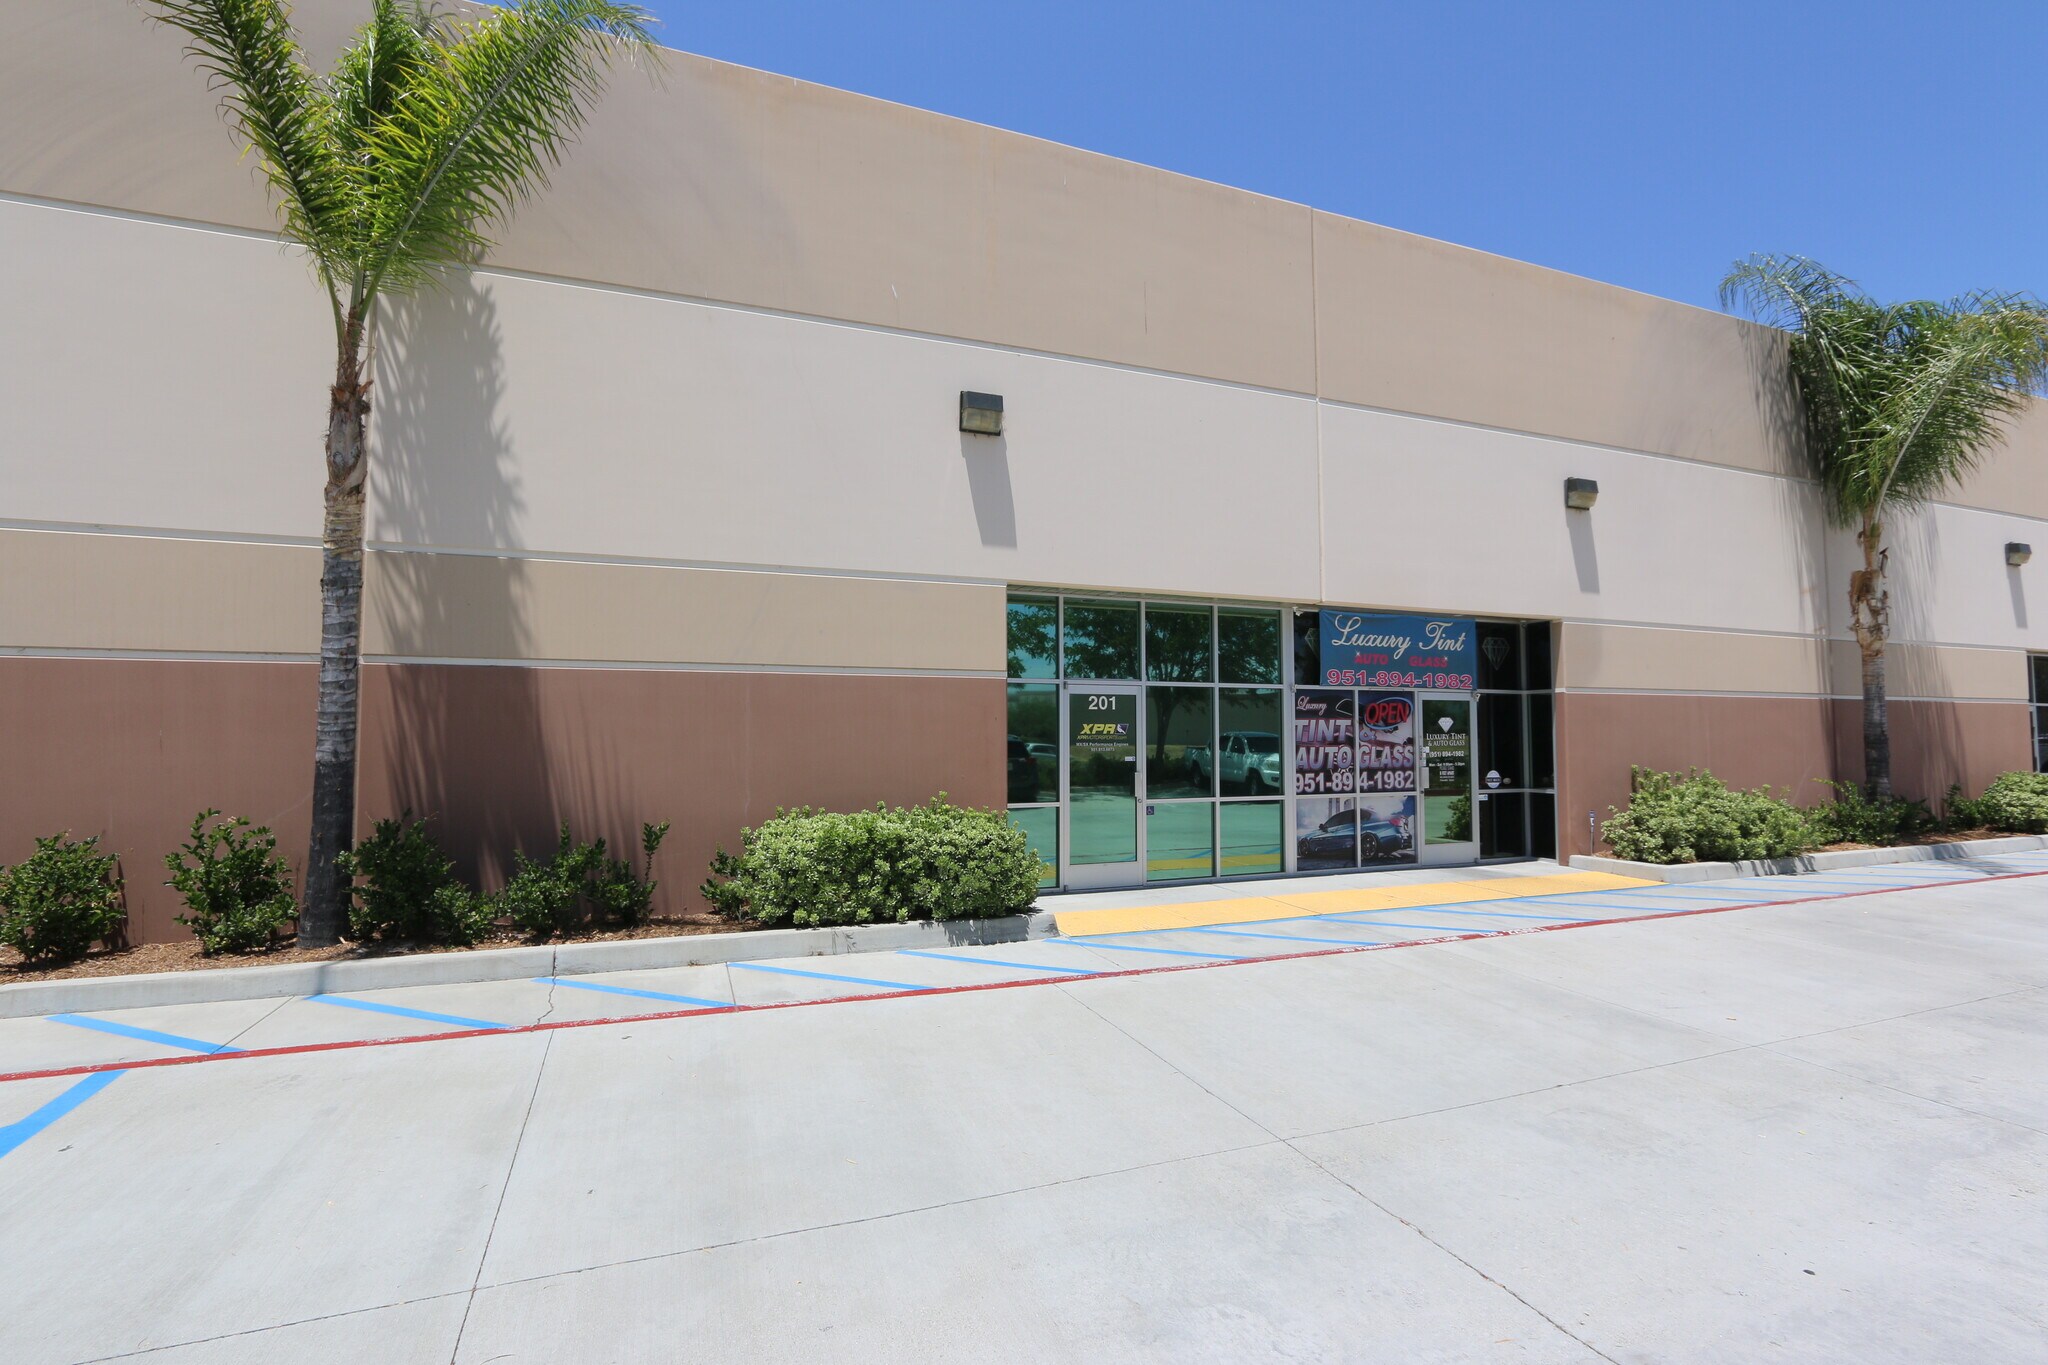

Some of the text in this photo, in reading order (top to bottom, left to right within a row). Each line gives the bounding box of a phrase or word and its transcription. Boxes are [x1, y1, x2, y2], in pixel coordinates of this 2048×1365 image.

[1332, 615, 1466, 660] Luxury Tint
[1354, 654, 1448, 668] AUTO GLASS
[1327, 669, 1472, 689] 951-894-1982
[1088, 696, 1115, 710] 201
[1296, 696, 1327, 715] Luxury
[1365, 703, 1409, 723] OPEN
[1080, 724, 1116, 734] XPR
[1295, 719, 1352, 742] TINT
[1296, 745, 1414, 769] AUTO GLASS
[1296, 771, 1414, 793] 951-894-1982
